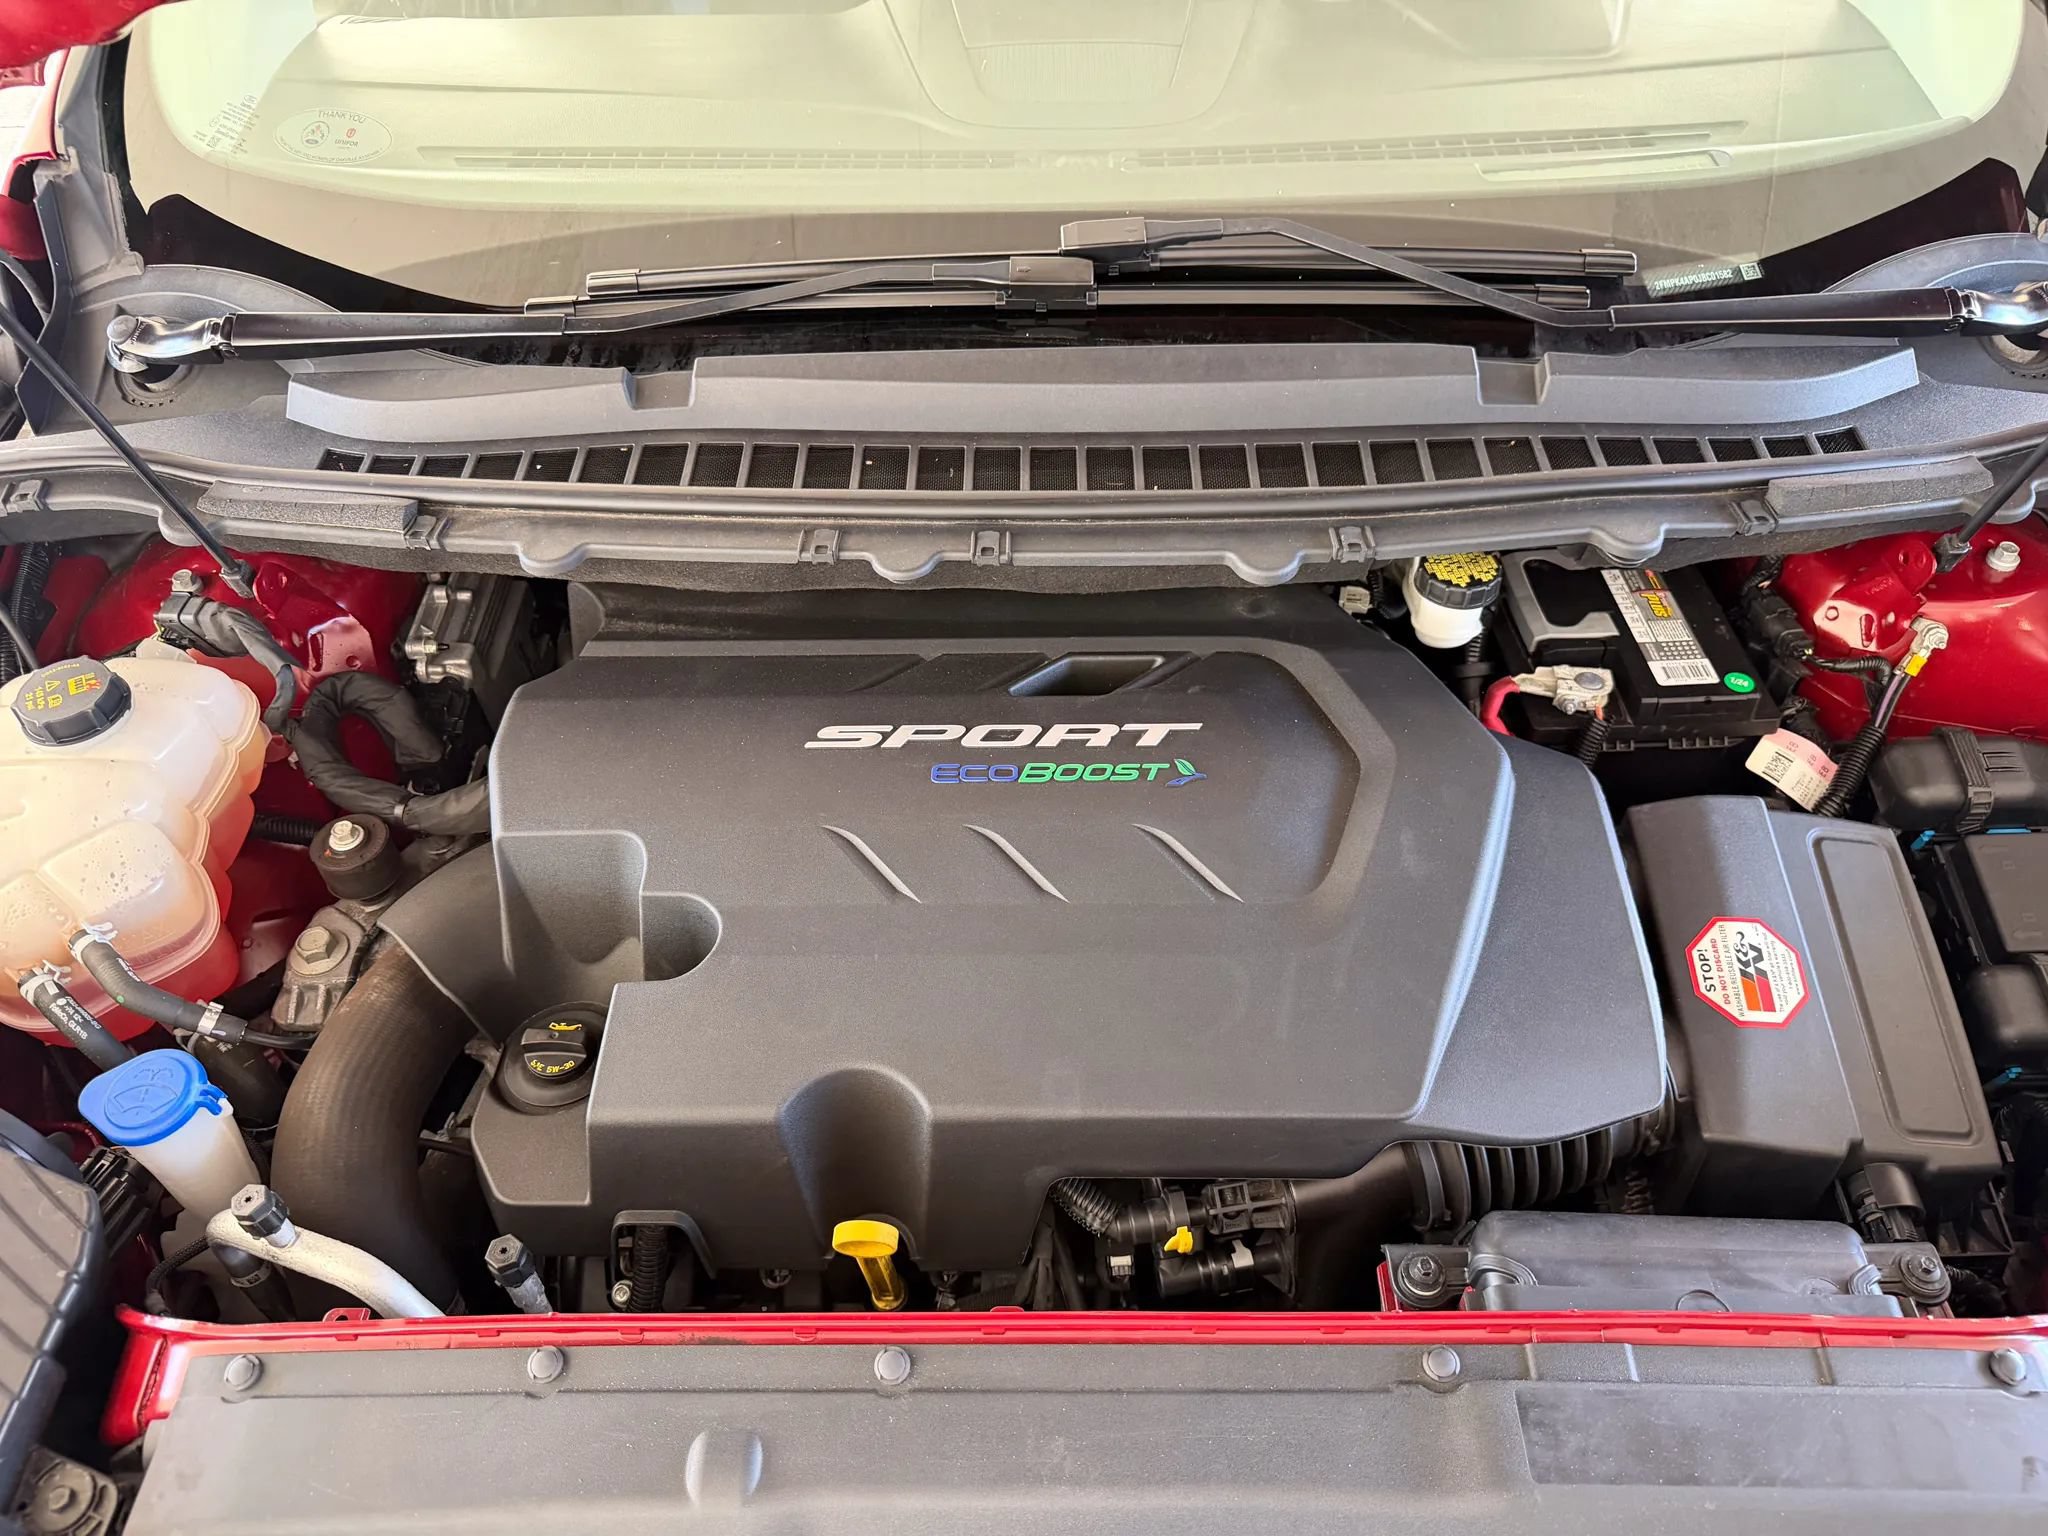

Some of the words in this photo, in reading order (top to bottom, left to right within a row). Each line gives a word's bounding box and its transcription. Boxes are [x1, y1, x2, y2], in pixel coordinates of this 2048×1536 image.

[317, 110, 347, 120] THANK
[348, 112, 367, 124] YOU
[804, 723, 1203, 749] SPORT
[1718, 924, 1728, 942] FILTER
[1710, 938, 1723, 972] DISCARD
[1697, 948, 1716, 992] STOP!
[1719, 975, 1727, 990] NOT
[1722, 993, 1731, 1004] DO
[546, 1060, 575, 1073] 5W-30
